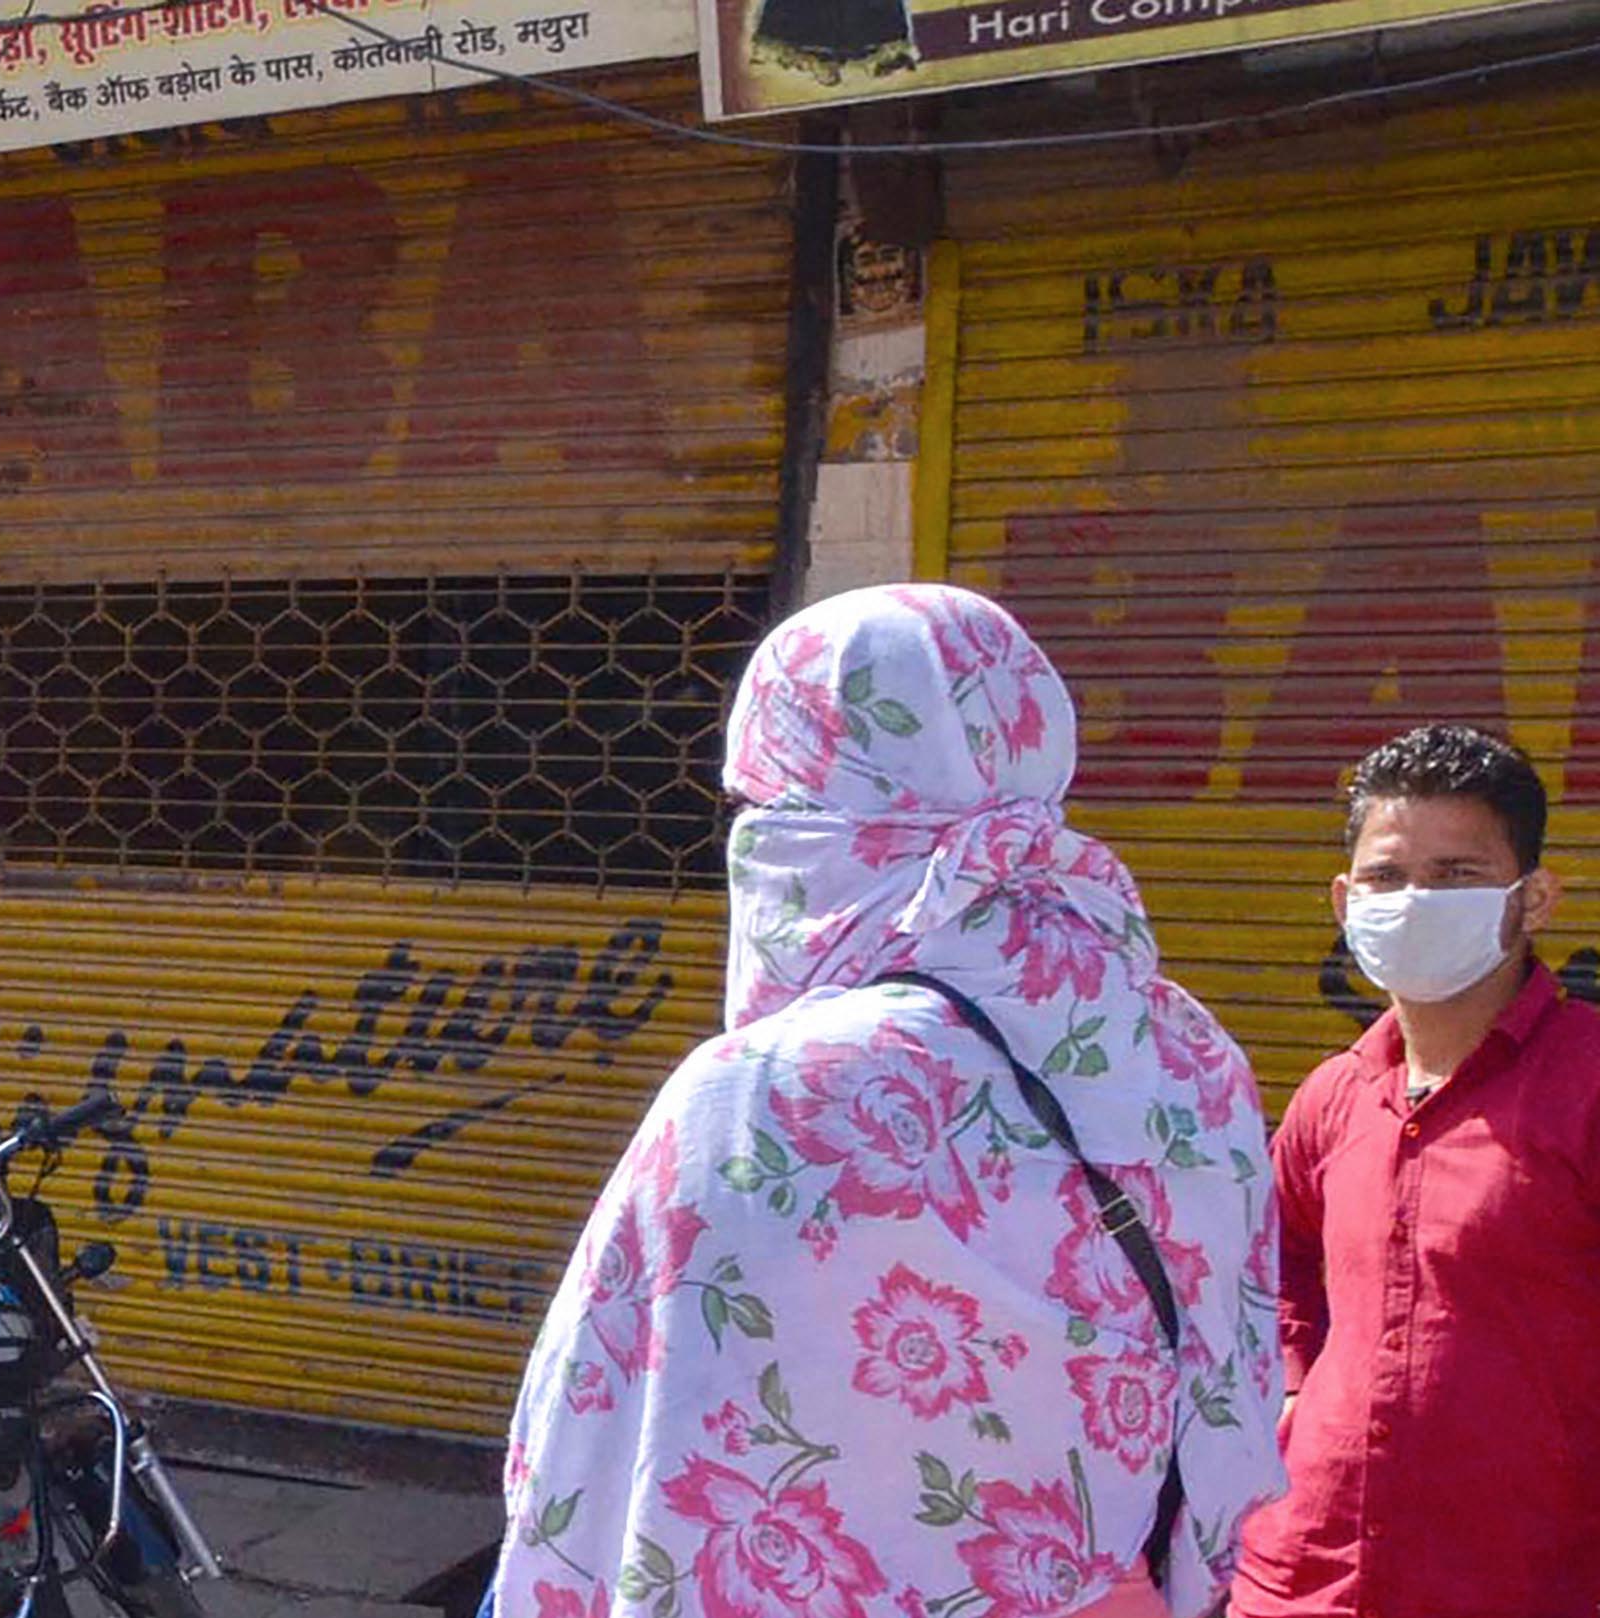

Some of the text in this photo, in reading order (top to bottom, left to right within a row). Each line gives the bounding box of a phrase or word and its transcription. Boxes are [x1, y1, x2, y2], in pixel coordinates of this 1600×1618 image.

[969, 0, 1246, 43] Hari Comp
[44, 81, 87, 112] बैंक
[229, 54, 256, 87] के
[263, 52, 324, 82] पास,
[332, 25, 446, 72] कोतवाली
[453, 19, 506, 57] रोड,
[157, 1217, 314, 1296] VEST
